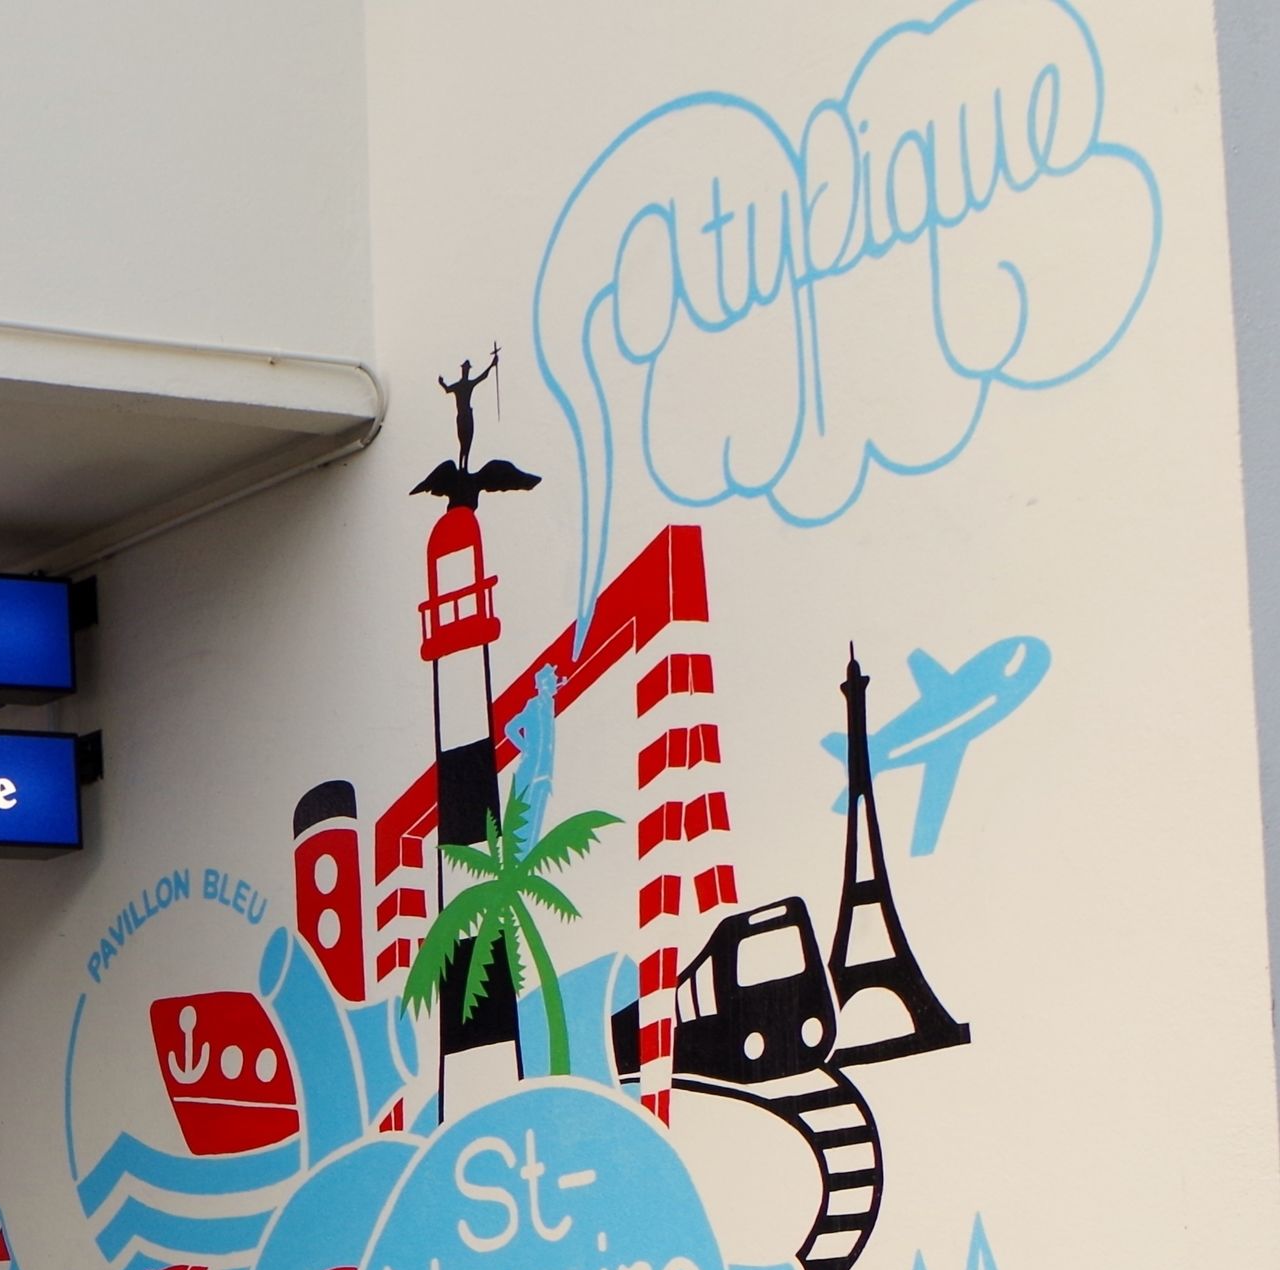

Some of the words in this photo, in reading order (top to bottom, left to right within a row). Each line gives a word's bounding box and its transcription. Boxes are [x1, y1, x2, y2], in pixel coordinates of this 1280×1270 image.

[610, 60, 1095, 440] atypique
[87, 868, 190, 984] PAVILLON
[202, 868, 268, 925] BLEU
[453, 1128, 598, 1253] St-
